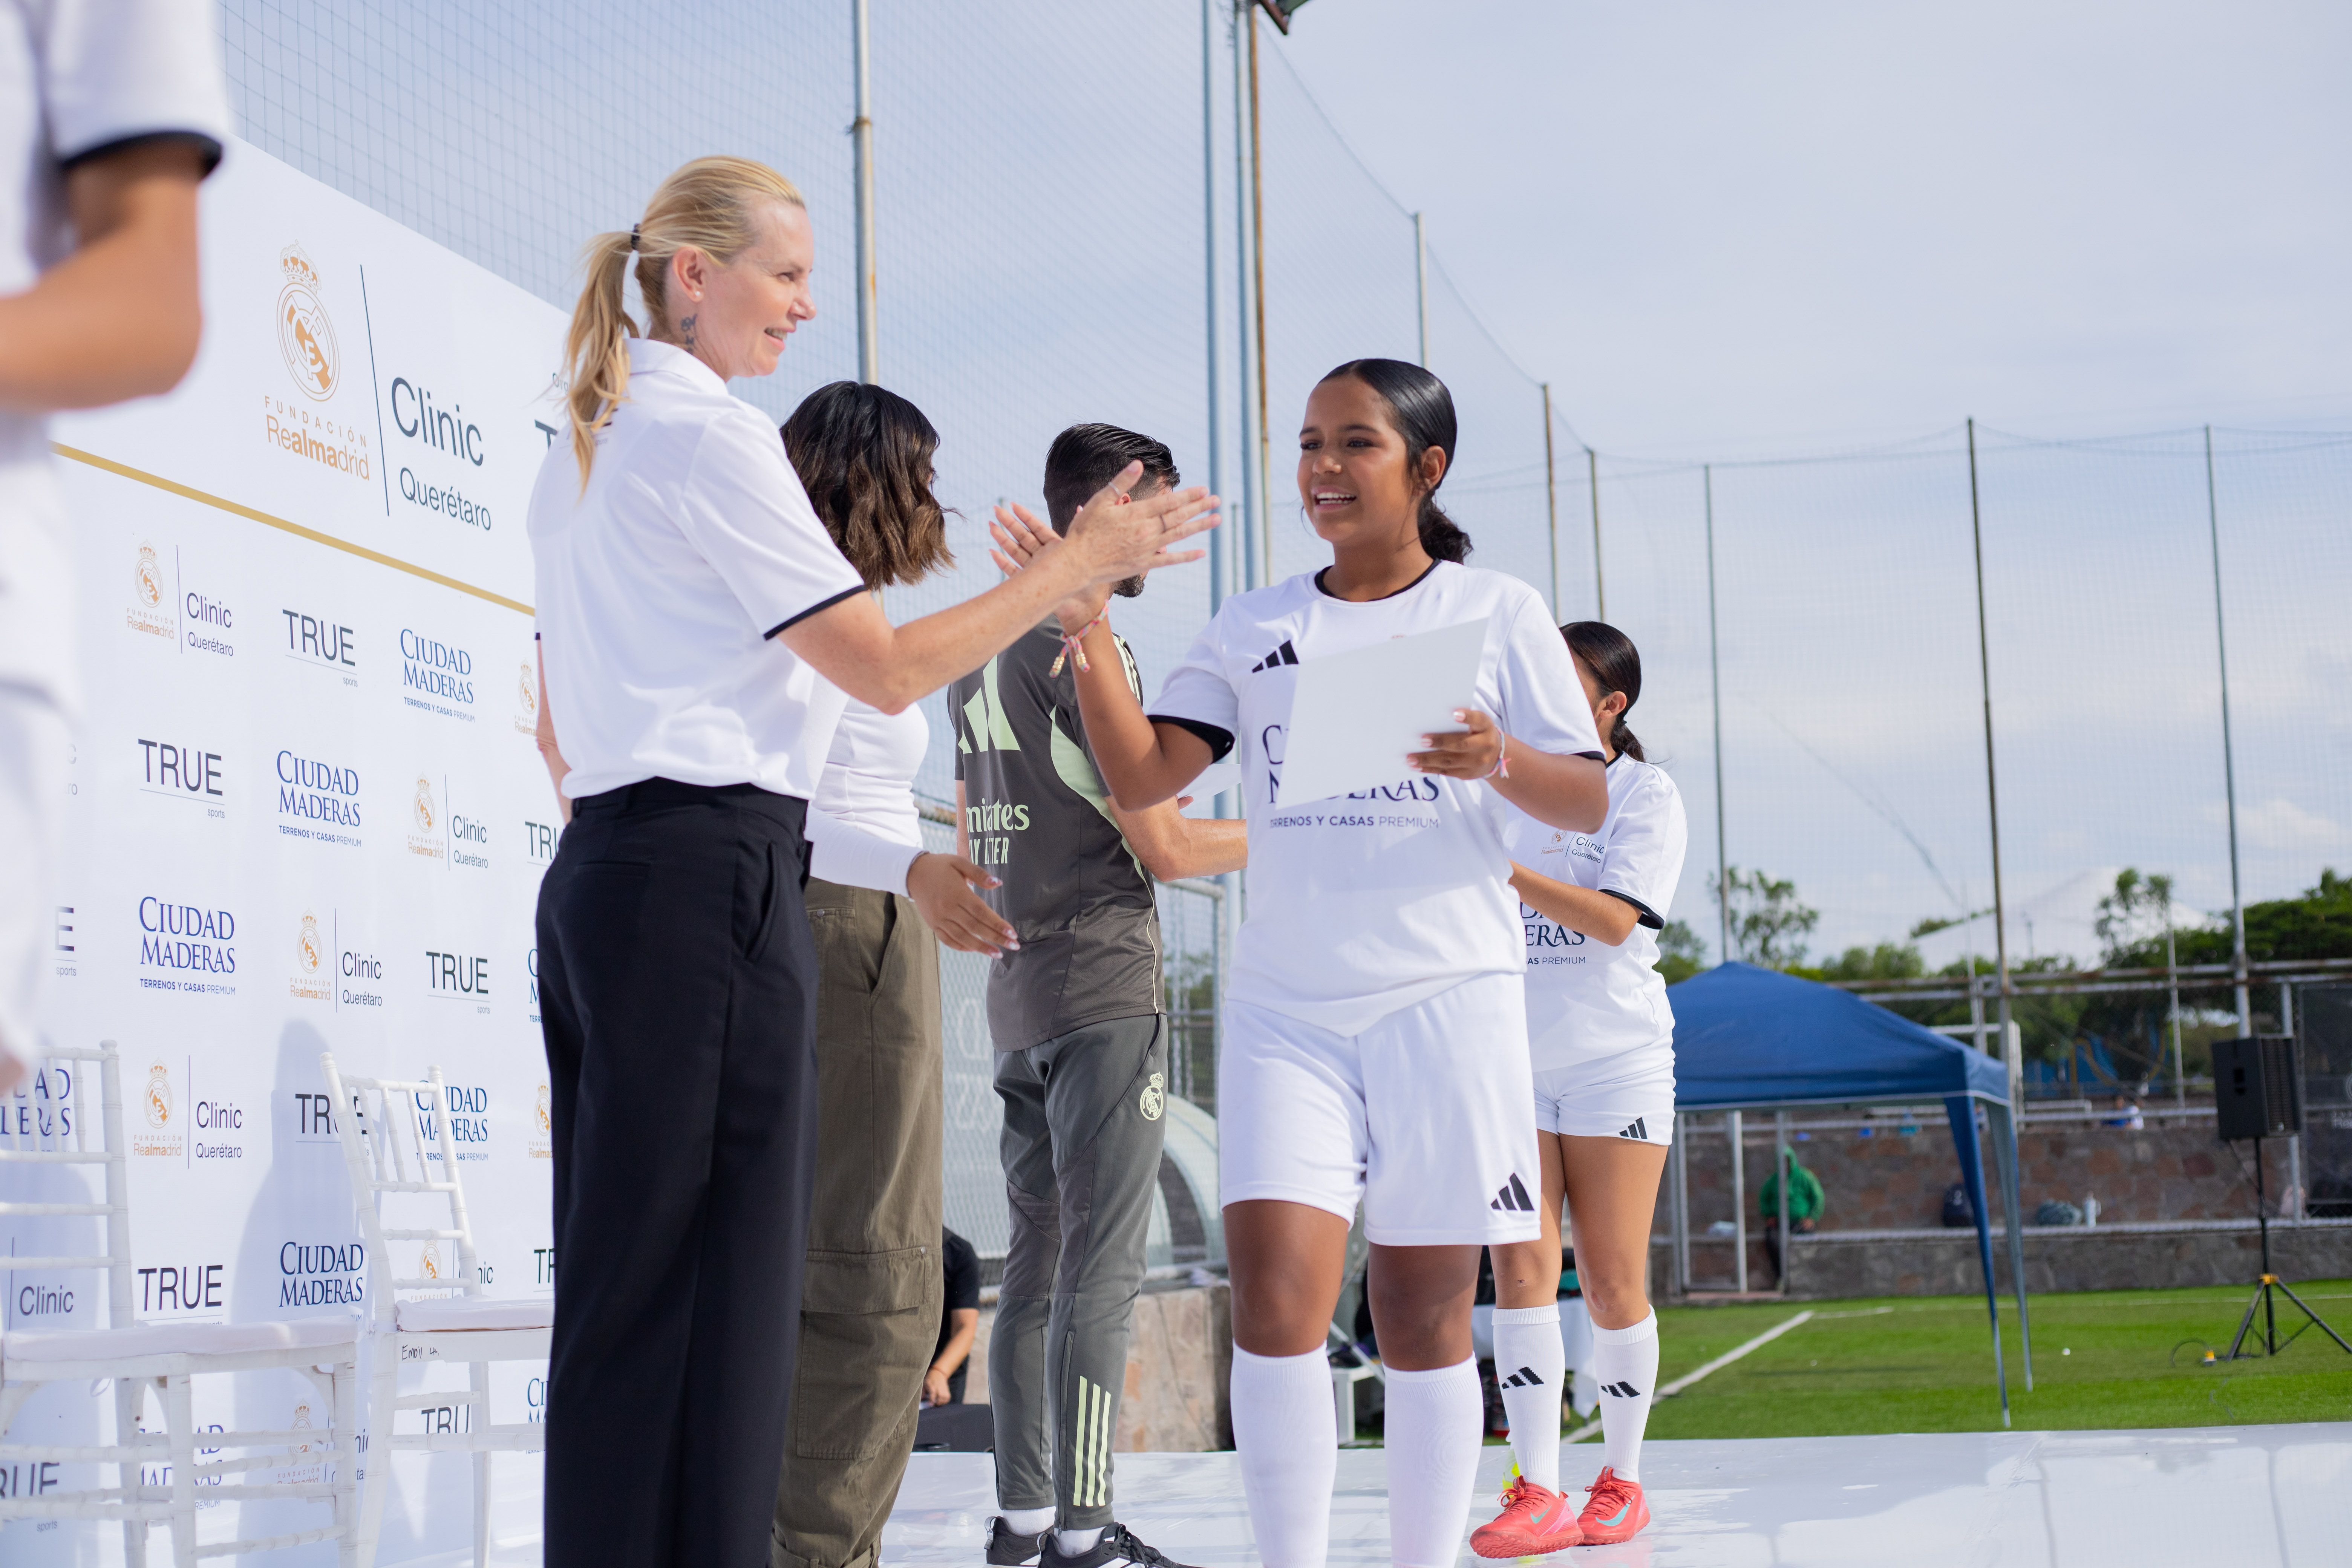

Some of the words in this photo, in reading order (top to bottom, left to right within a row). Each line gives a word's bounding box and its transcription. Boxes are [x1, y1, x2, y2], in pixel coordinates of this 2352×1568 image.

[265, 395, 367, 447] FUNDACIÓN
[391, 377, 483, 466] Clinic
[266, 413, 369, 481] Realmadrid
[400, 467, 491, 531] Querétaro
[127, 608, 173, 625] FUNDACIÓN
[187, 592, 232, 628] Clinic
[127, 616, 174, 639] Realmadrid
[282, 609, 355, 666] TRUE
[188, 632, 233, 656] Querétaro
[400, 629, 471, 675] CIUDAD
[343, 676, 358, 687] sports
[403, 659, 473, 704] MADERAS
[404, 697, 430, 711] TERRENOS
[432, 704, 435, 712] Y
[436, 706, 452, 717] CASAS
[453, 710, 475, 723] PREMIUM
[138, 738, 223, 796] TRUE
[277, 750, 359, 796] CIUDAD
[207, 808, 225, 819] sports
[279, 783, 360, 826] MADERAS
[453, 815, 487, 843] Clinic
[1316, 816, 1325, 825] Y
[1329, 816, 1374, 826] CASAS
[1379, 816, 1439, 828] PREMIUM
[279, 825, 309, 838] TERRENOS
[310, 831, 315, 839] Y
[317, 831, 335, 843] CASAS
[337, 835, 361, 848] PREMIUM
[408, 835, 443, 847] FUNDACIÓN
[1576, 837, 1604, 854] Clinic
[408, 842, 443, 859] Realmadrid
[454, 850, 488, 868] Querétaro
[1572, 849, 1601, 863] Querétaro
[139, 896, 234, 940] CIUDAD
[140, 933, 235, 973] MADERAS
[342, 951, 381, 979] Clinic
[56, 966, 76, 977] sports
[290, 977, 331, 987] FUNDACIÓN
[426, 951, 488, 994] TRUE
[140, 978, 175, 990] TERRENOS
[184, 982, 205, 992] CASAS
[207, 985, 236, 995] PREMIUM
[290, 985, 331, 1001] Realmadrid
[343, 989, 382, 1006] Querétaro
[477, 1006, 490, 1014] sports
[196, 1101, 242, 1129] Clinic
[134, 1143, 181, 1156] Realmadrid
[196, 1142, 242, 1158] Querétaro
[467, 1153, 488, 1161] PREMIUM
[280, 1242, 363, 1275] CIUDAD
[19, 1285, 74, 1316] Clinic
[138, 1265, 223, 1312] TRUE
[279, 1277, 363, 1307] MADERAS
[277, 1467, 320, 1479] FUNDACIÓN
[37, 1520, 57, 1533] sports
